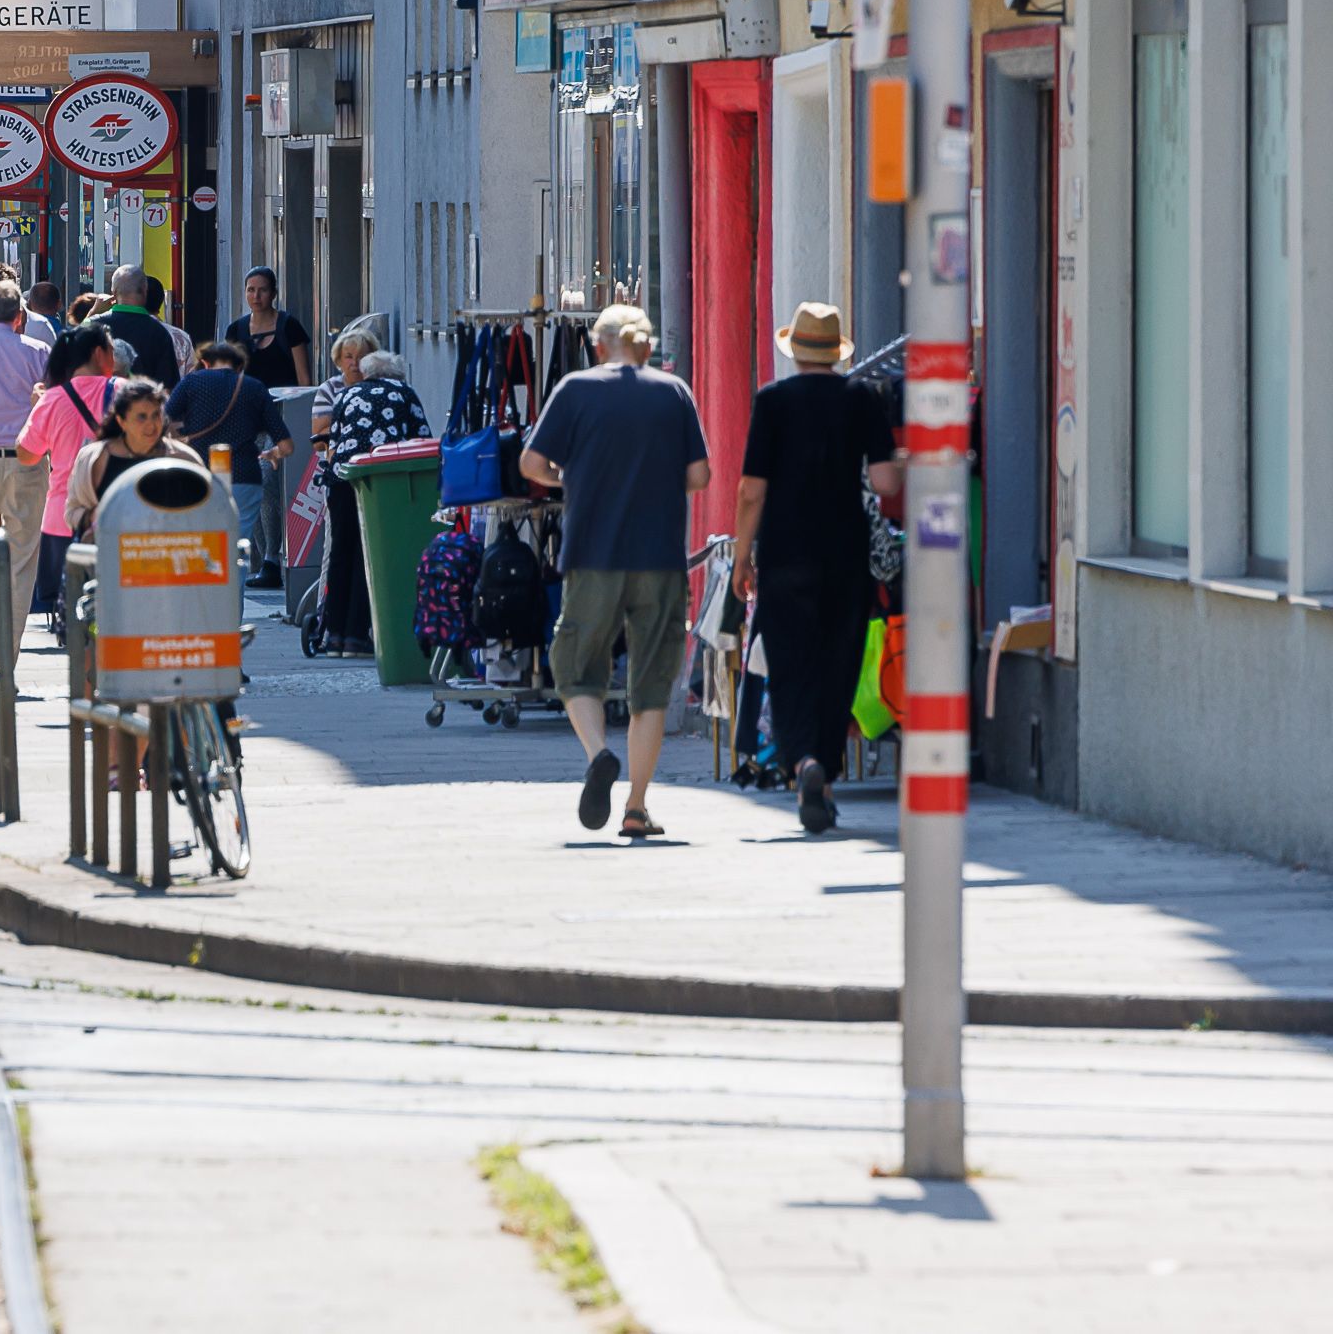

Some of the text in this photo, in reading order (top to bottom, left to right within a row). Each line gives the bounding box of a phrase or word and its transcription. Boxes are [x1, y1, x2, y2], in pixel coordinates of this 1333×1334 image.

[61, 87, 162, 123] STRASSENBAHN
[65, 136, 158, 168] HALTESTELLE
[124, 196, 140, 207] 11
[147, 208, 164, 221] 71
